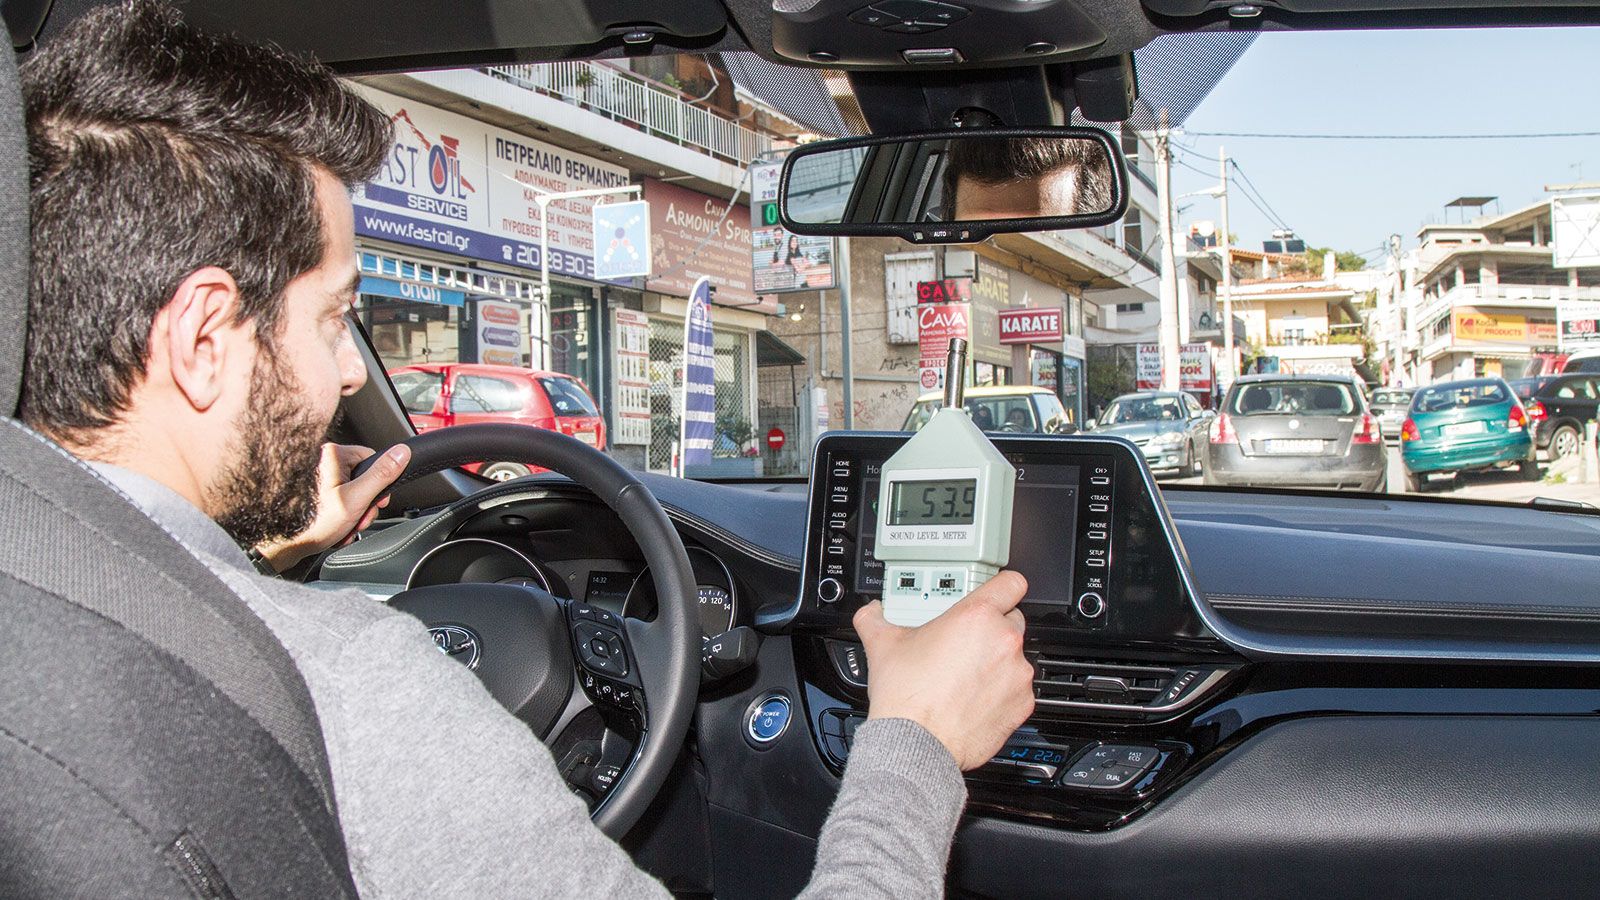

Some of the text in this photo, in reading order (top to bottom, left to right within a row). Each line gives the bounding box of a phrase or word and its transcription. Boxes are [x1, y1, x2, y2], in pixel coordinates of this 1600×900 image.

[495, 137, 628, 190] ΠΕΤΡΕΛΑΙΟ ΘΕΡΜΑΝΣΗΣ
[407, 194, 468, 221] SERVICE
[363, 216, 470, 251] www.fastoil.gr
[516, 245, 540, 266] 210
[565, 254, 585, 275] 30
[1001, 315, 1059, 334] KARATE
[866, 465, 881, 475] Ho
[889, 531, 968, 540] SOUND LEVEL METER
[592, 576, 607, 584] 14:32
[711, 597, 723, 605] 120
[1106, 774, 1121, 782] DUAL
